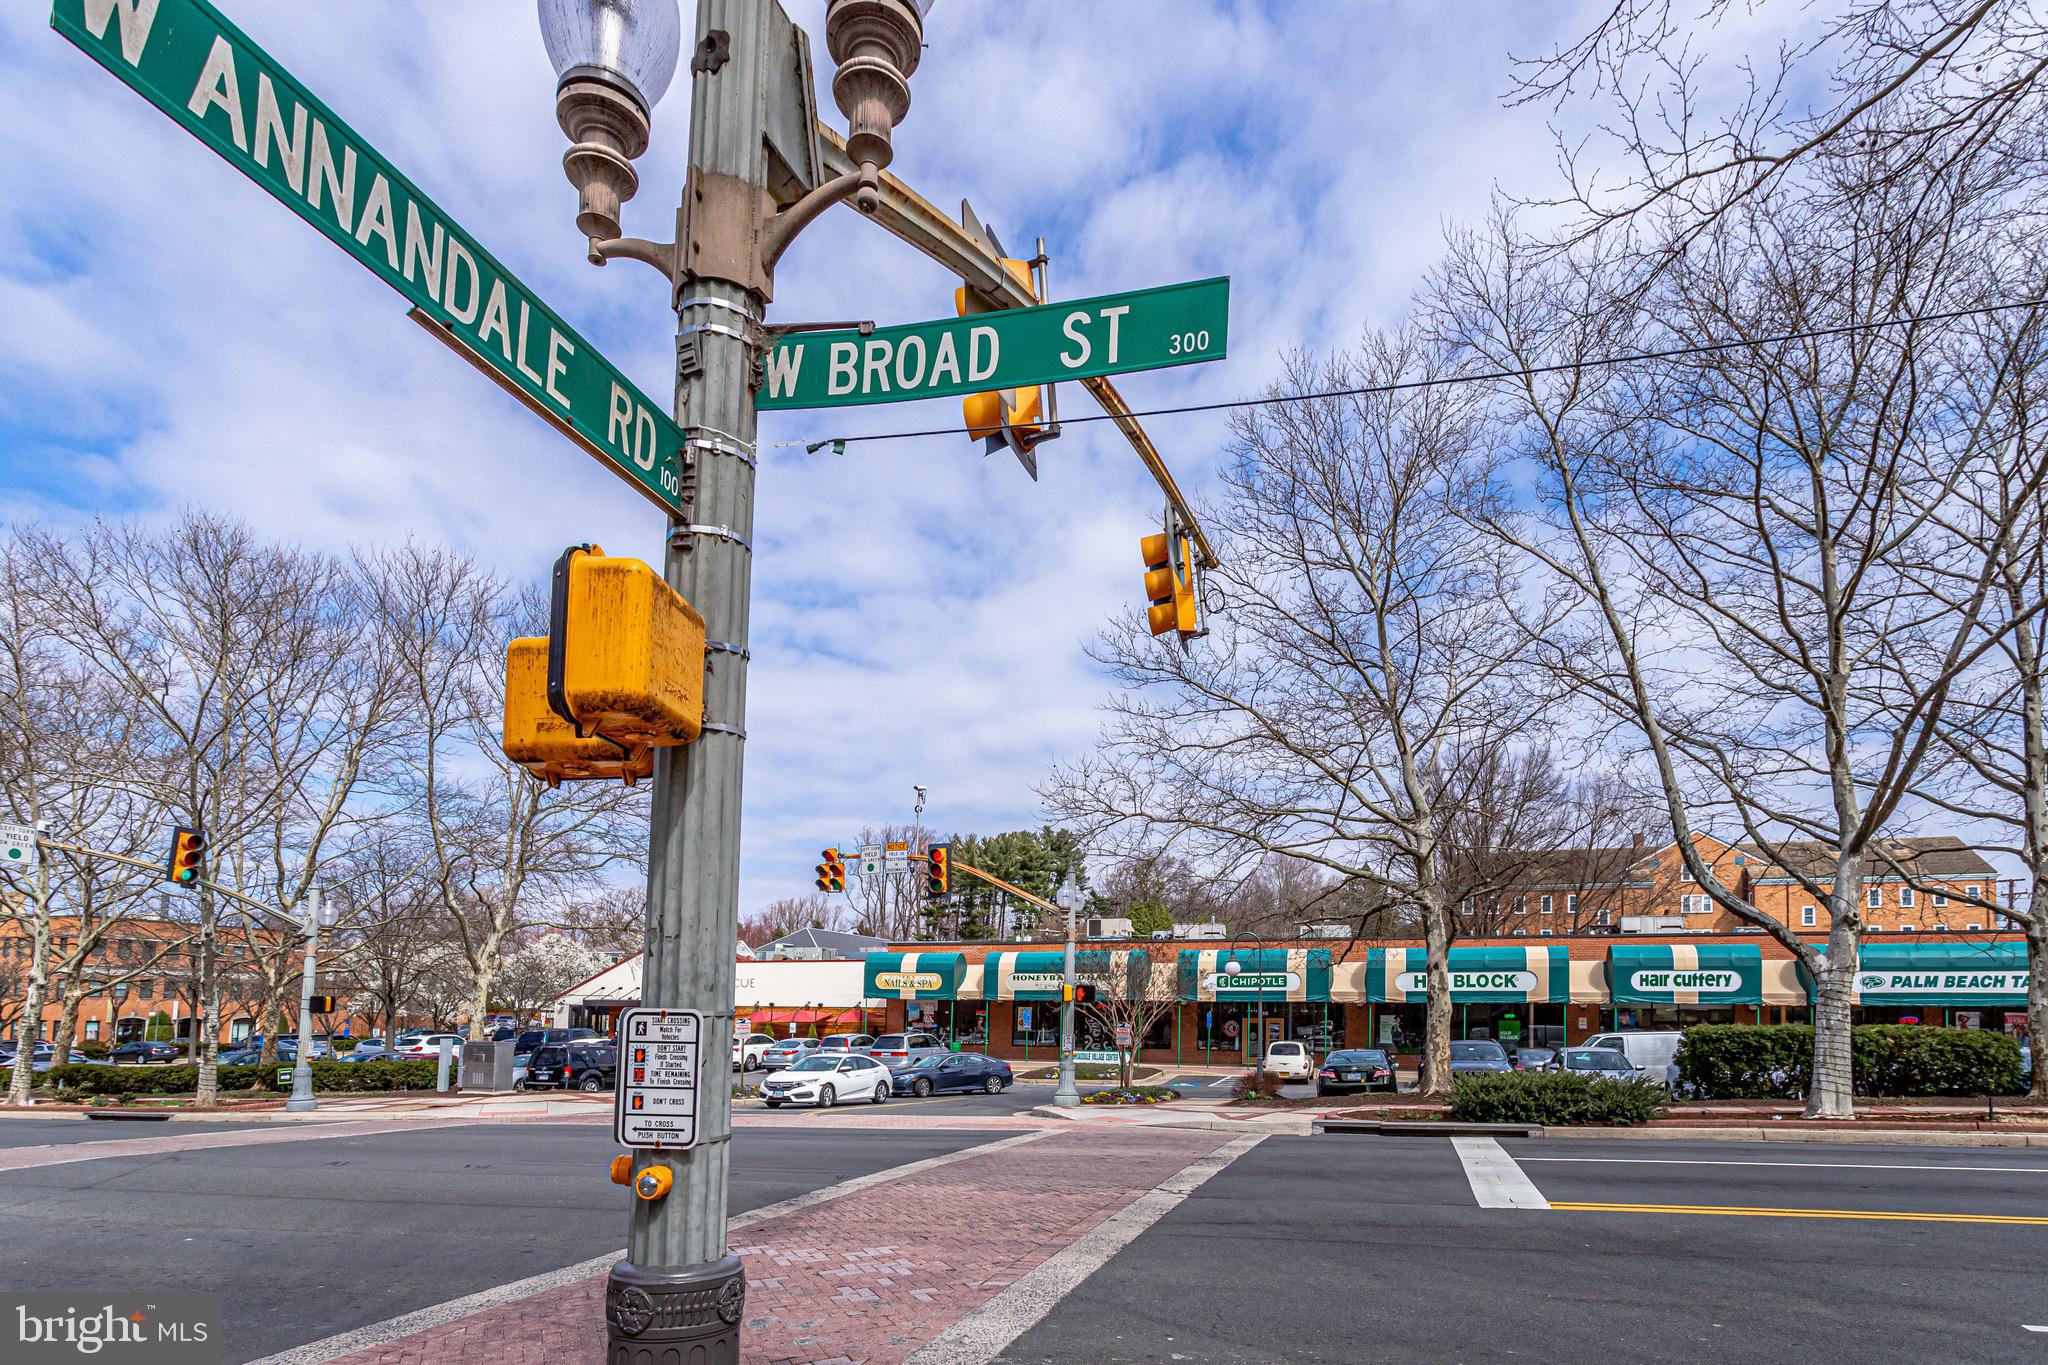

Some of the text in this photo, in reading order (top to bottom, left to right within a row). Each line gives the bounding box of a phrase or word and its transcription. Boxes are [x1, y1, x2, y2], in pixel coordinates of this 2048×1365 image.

[85, 0, 657, 471] W ANNANDALE RD
[1168, 330, 1210, 355] 300
[766, 305, 1130, 398] W BROAD ST
[661, 466, 679, 496] 100
[6, 832, 29, 841] YIELD
[884, 979, 933, 988] NAILS & SPA
[1231, 977, 1285, 986] CHIPOTLE
[1453, 974, 1517, 988] BLOCK
[1891, 975, 2030, 988] PALM BEACH TA
[652, 1016, 666, 1024] START
[670, 1054, 688, 1062] Crossing
[665, 1070, 691, 1078] REMAINING
[673, 1078, 692, 1086] Crossing
[655, 1120, 674, 1128] CROSS
[638, 1131, 654, 1139] PUSH
